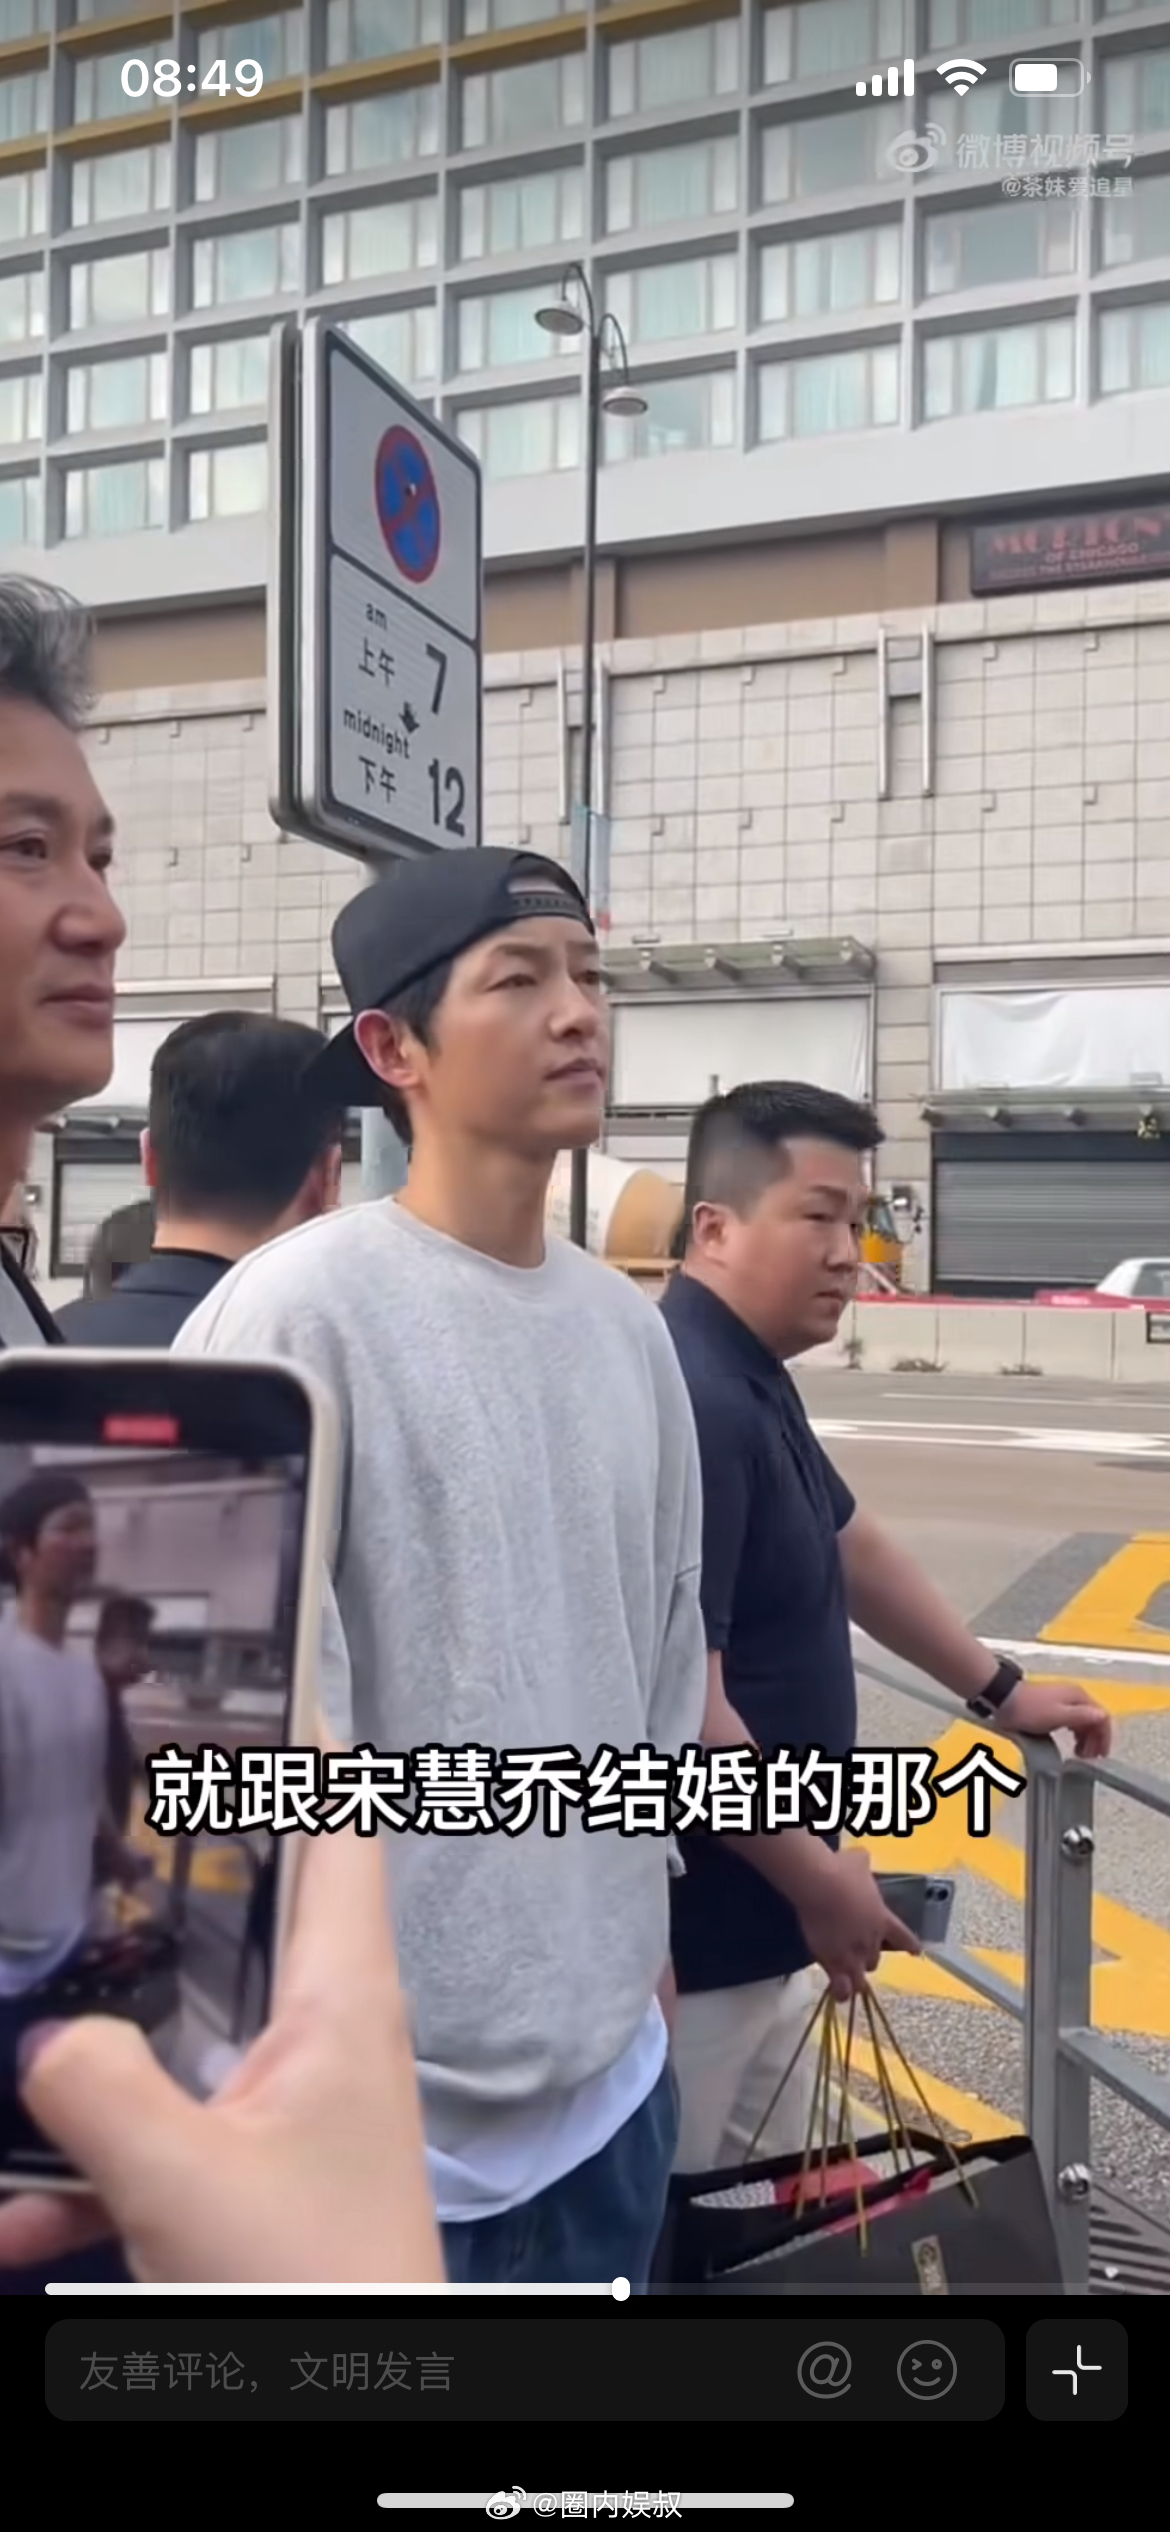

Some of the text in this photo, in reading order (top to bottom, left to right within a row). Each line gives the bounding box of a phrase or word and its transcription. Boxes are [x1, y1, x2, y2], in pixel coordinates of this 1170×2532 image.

[365, 603, 388, 630] am
[358, 637, 448, 715] 上午 7
[343, 709, 410, 759] midnight
[358, 755, 466, 838] 下午 12
